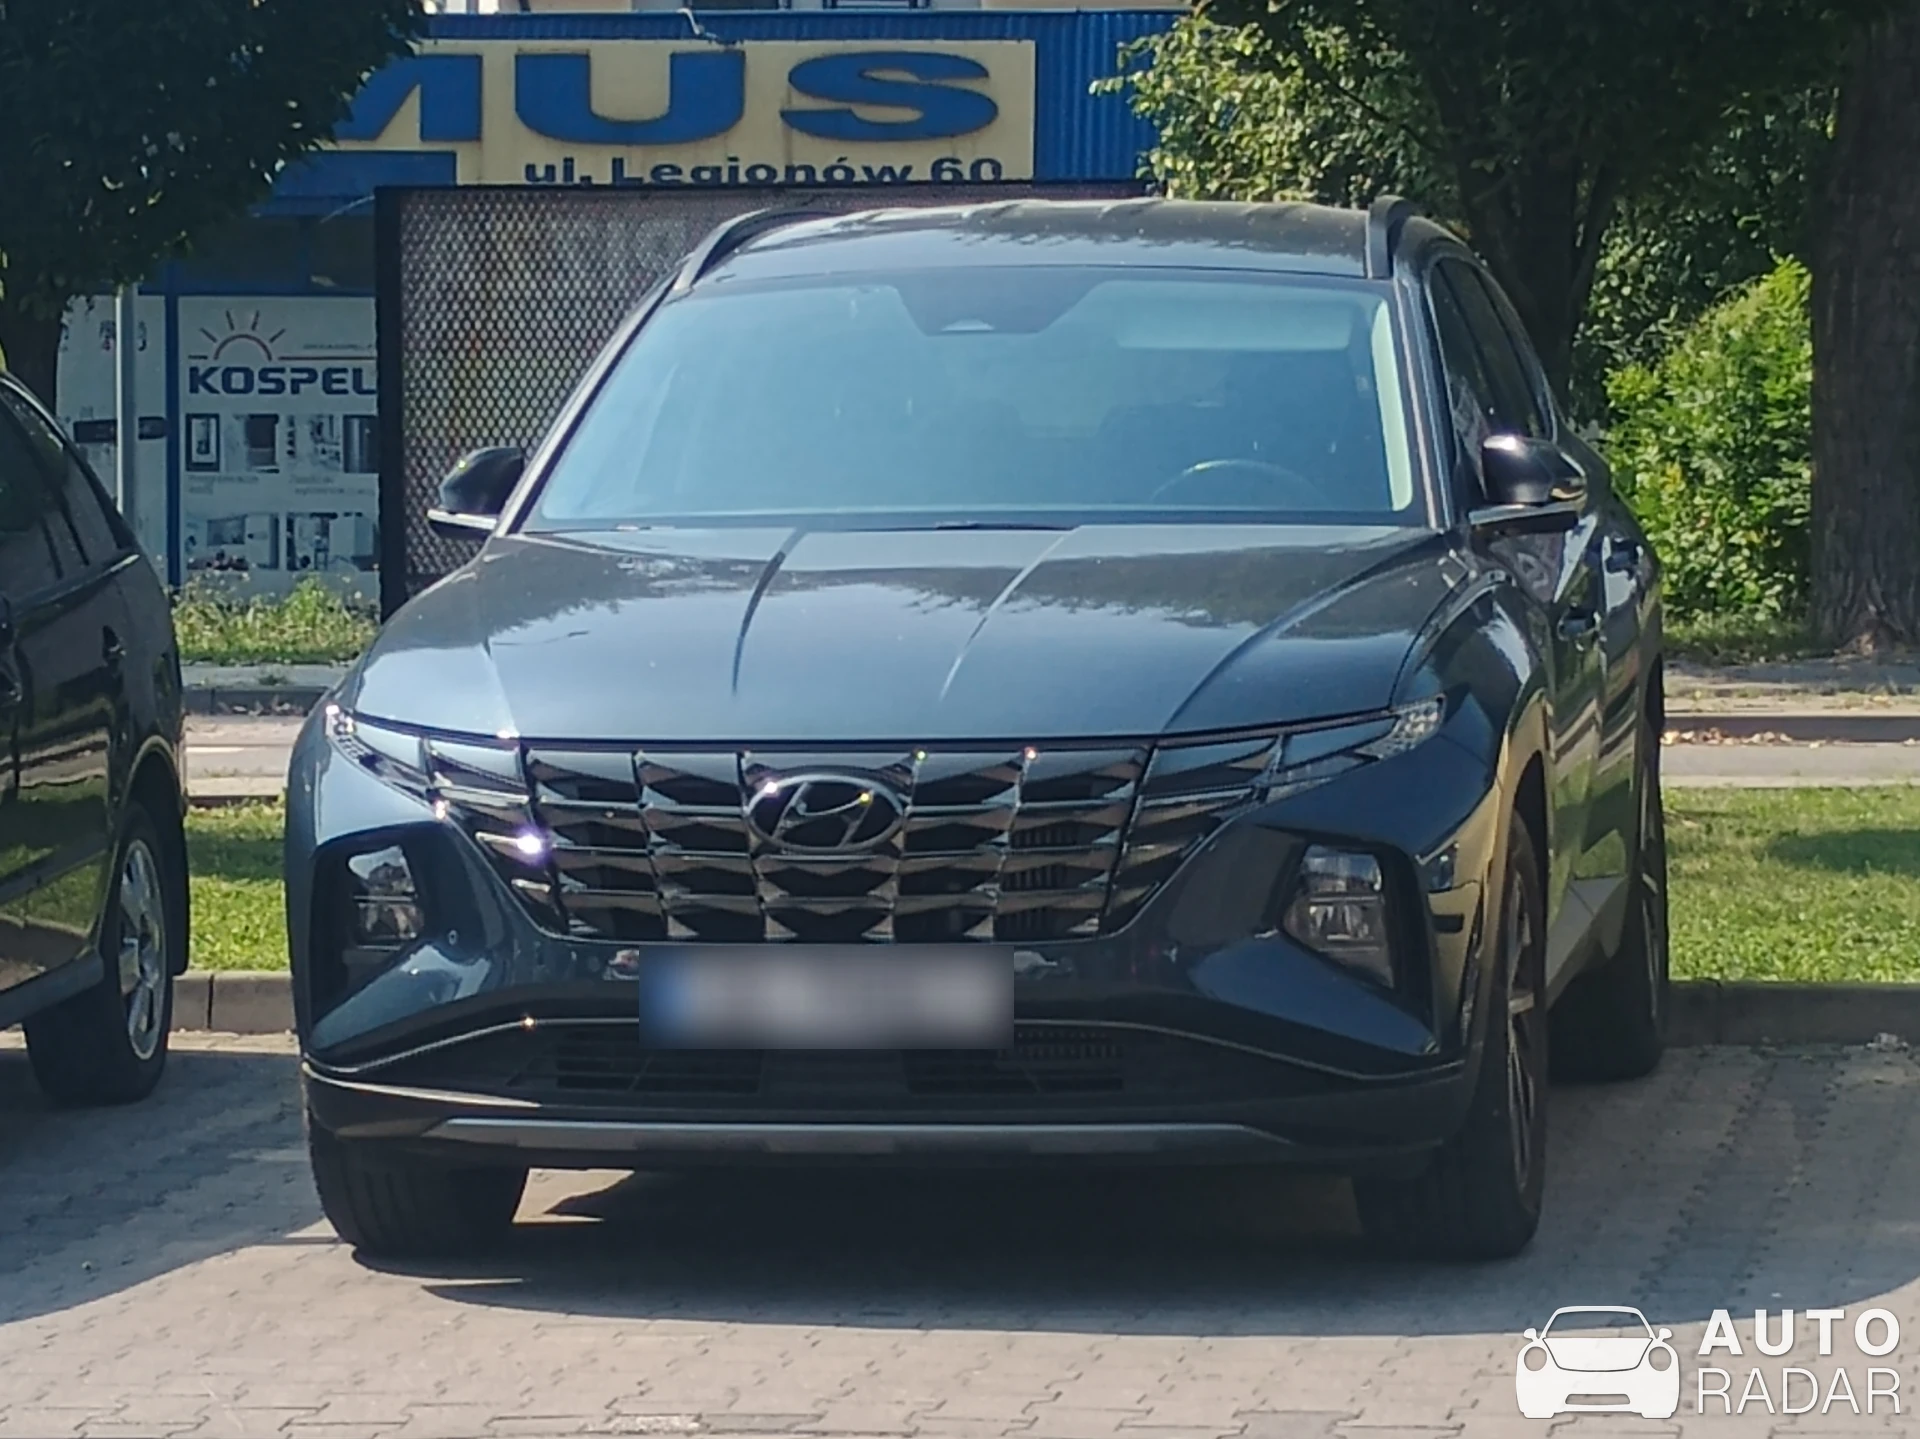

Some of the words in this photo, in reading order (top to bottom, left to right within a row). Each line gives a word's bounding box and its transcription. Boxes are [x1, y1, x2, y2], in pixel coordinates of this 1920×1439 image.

[525, 156, 592, 184] ul.
[930, 156, 1003, 186] 60
[188, 366, 377, 396] KOSPEL
